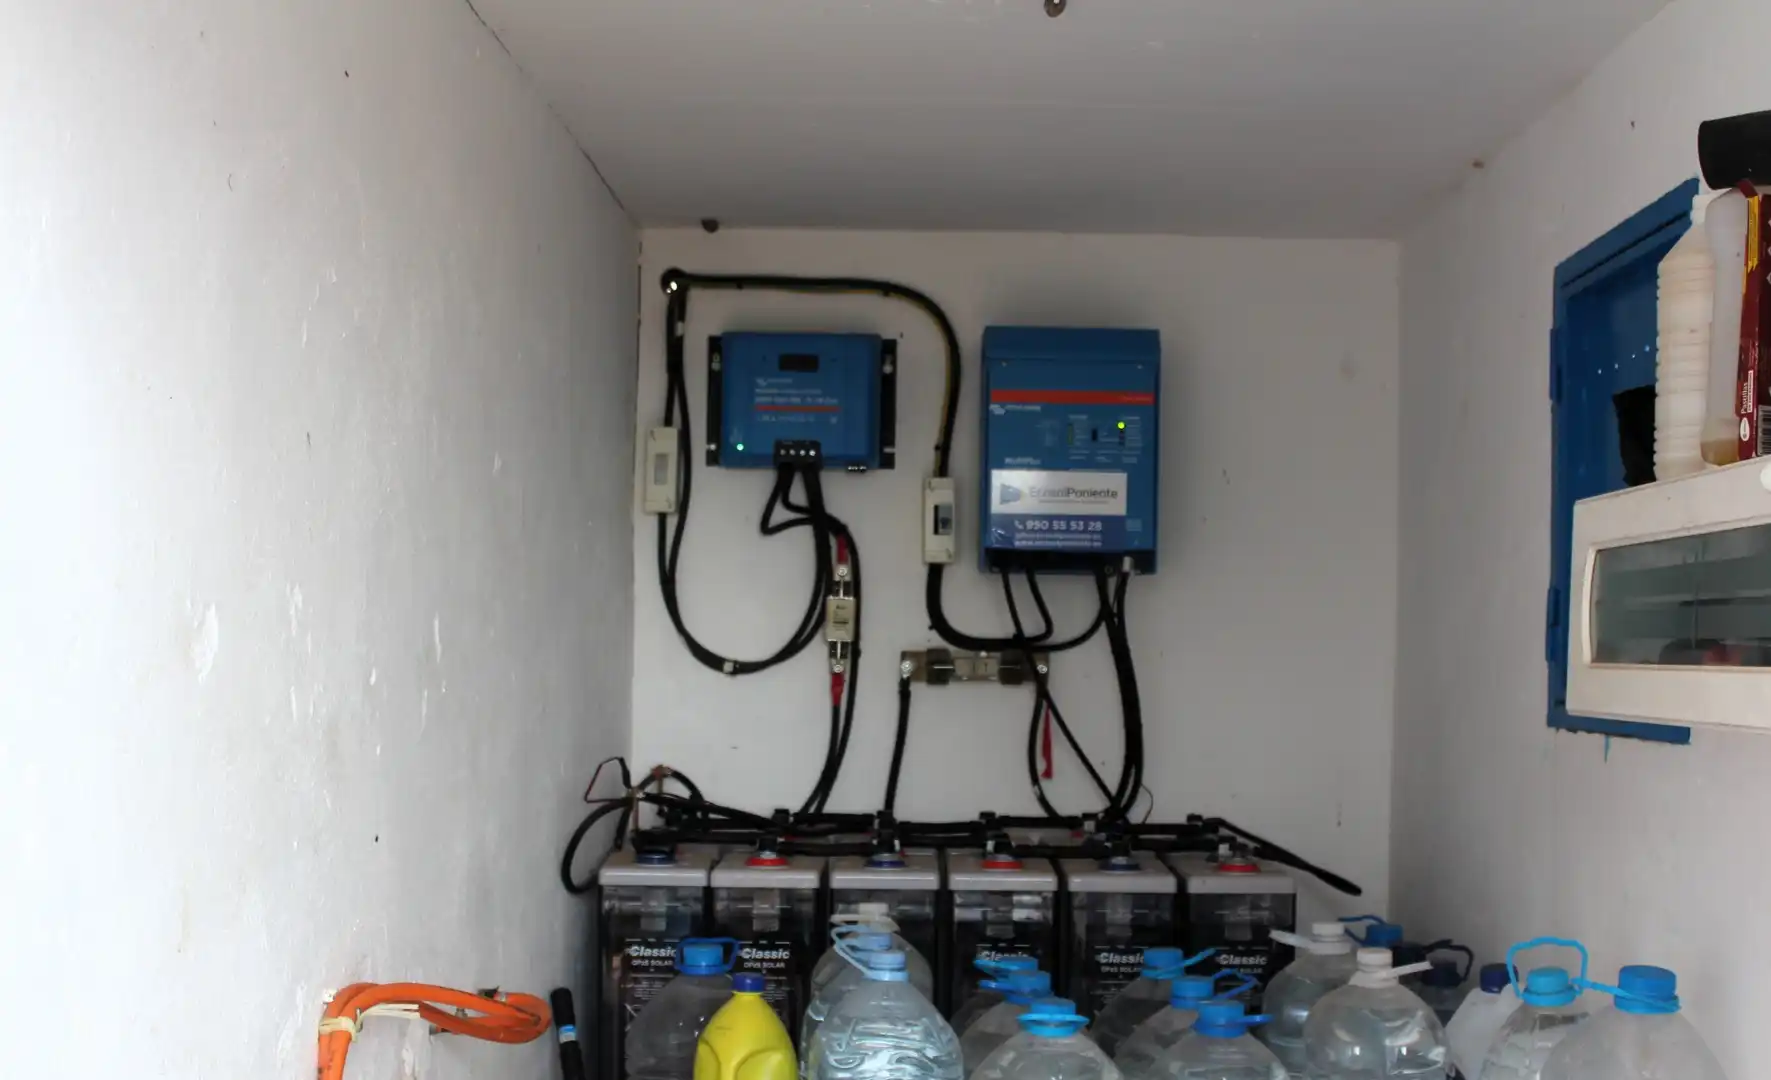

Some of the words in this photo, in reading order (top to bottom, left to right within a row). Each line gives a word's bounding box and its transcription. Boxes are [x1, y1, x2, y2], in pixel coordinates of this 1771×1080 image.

[1025, 519, 1049, 531] 950
[1052, 520, 1067, 531] 55
[1070, 520, 1084, 531] 53
[1088, 521, 1103, 532] 28
[741, 948, 790, 959] Classic
[1219, 953, 1269, 965] Classic
